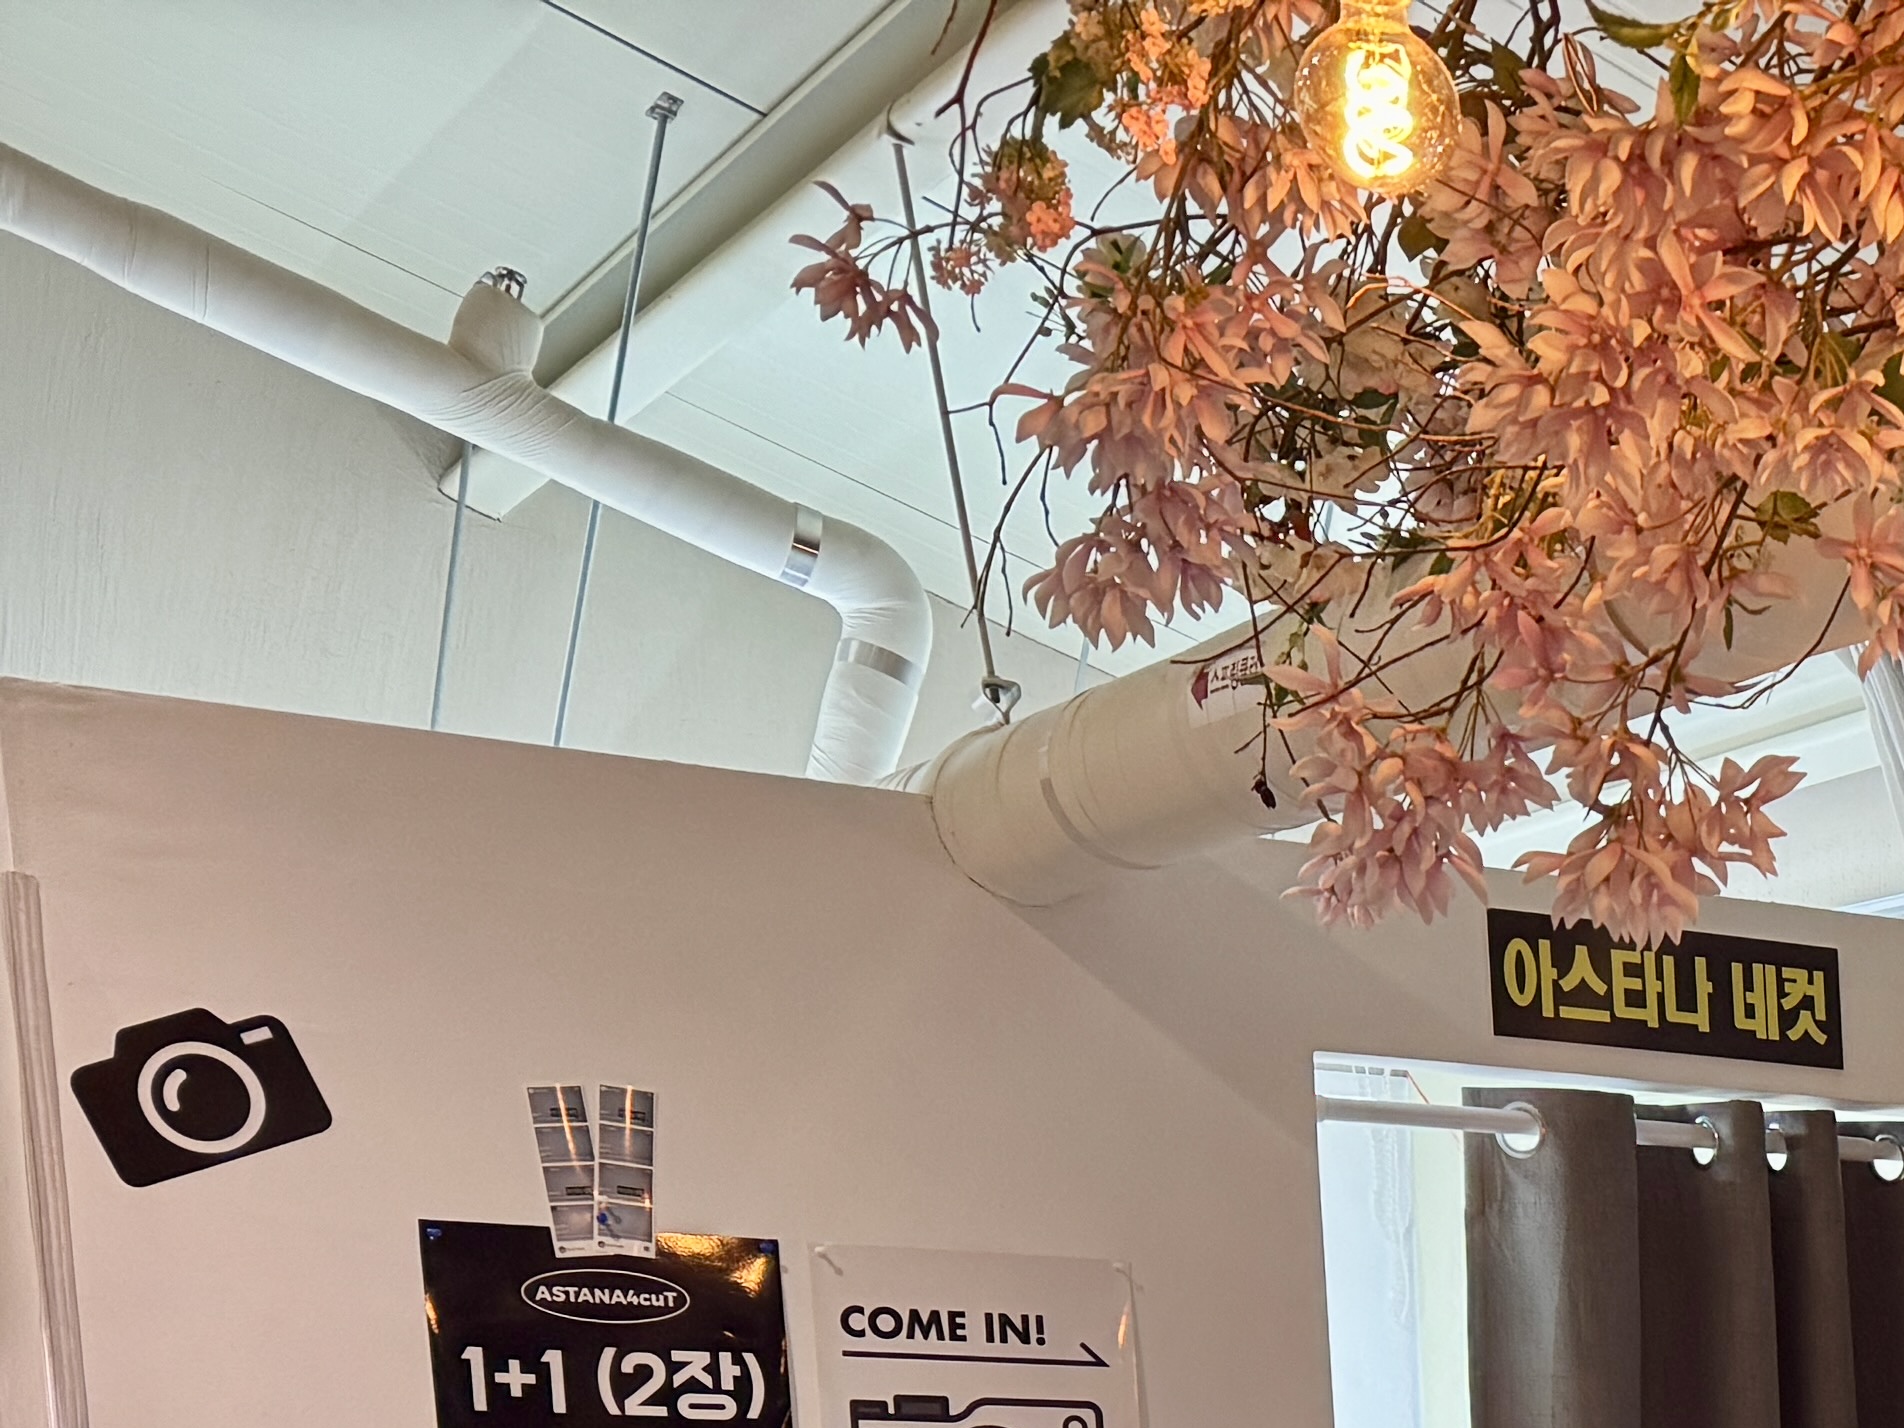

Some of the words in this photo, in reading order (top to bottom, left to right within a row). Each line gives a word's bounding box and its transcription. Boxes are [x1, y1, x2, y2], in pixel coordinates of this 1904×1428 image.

[1503, 937, 1713, 1033] 아스타나
[1731, 961, 1828, 1046] 네컷
[840, 1304, 967, 1342] COME
[984, 1312, 1046, 1346] IN!
[460, 1346, 567, 1414] 1+1
[597, 1346, 765, 1421] (2장)
